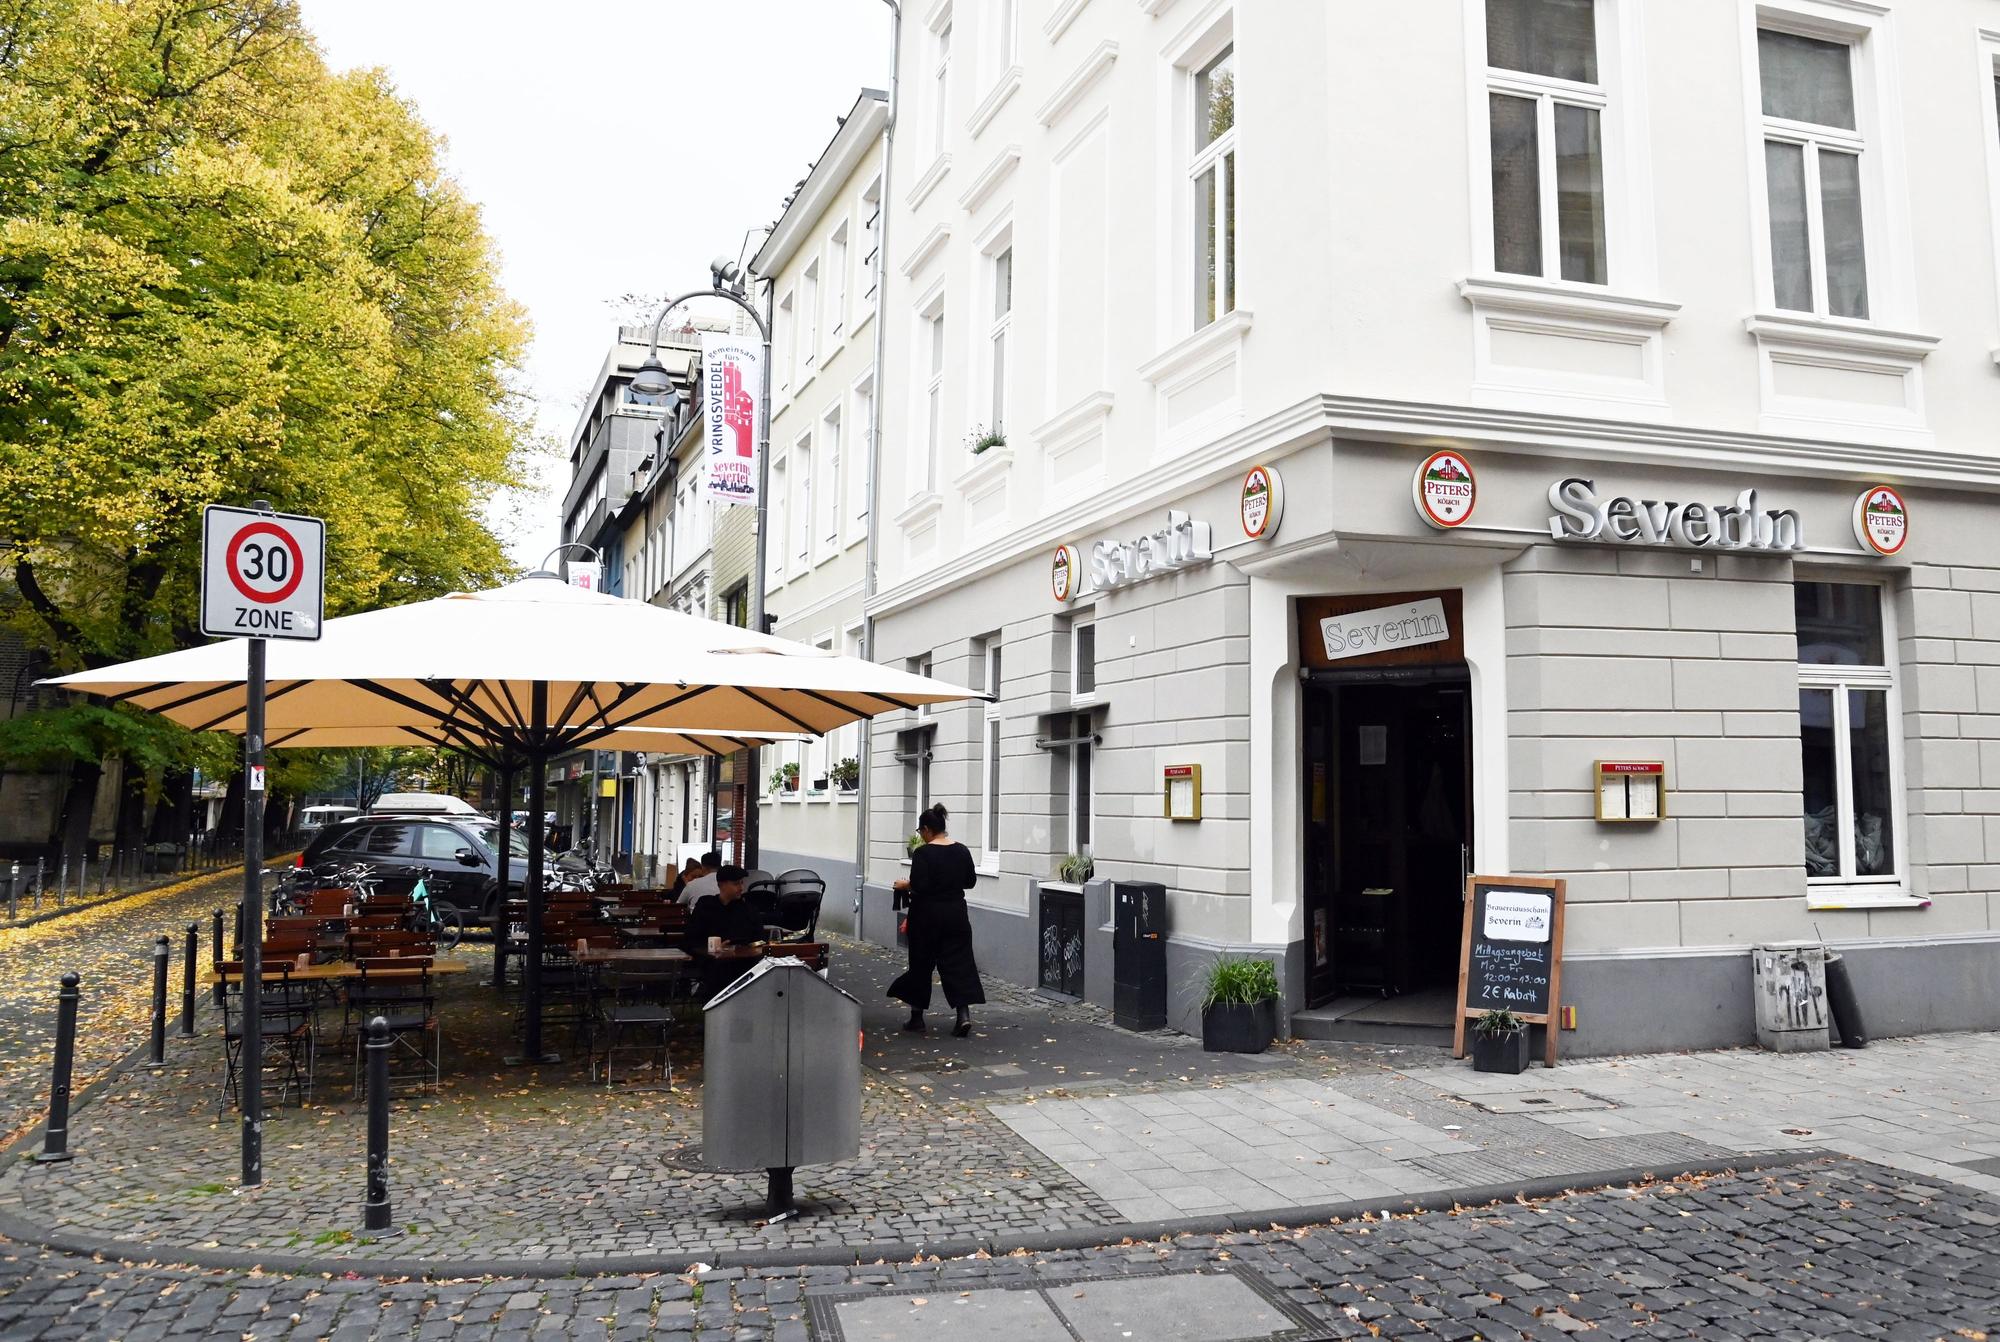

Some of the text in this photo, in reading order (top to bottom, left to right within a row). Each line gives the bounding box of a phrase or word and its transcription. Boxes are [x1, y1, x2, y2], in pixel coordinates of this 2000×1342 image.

[708, 346, 756, 362] gemeinsam
[711, 361, 723, 455] VRINGSVEEDEL
[1426, 481, 1470, 497] PETERS
[1245, 494, 1266, 511] PETERS
[1548, 478, 1808, 551] Severin
[1868, 513, 1903, 527] PETERS
[243, 543, 288, 582] 30
[235, 607, 293, 630] ZONE
[1325, 608, 1445, 653] Severin
[1488, 916, 1522, 926] Severin
[1480, 960, 1495, 971] Mo
[1503, 987, 1537, 1002] Rabatt
